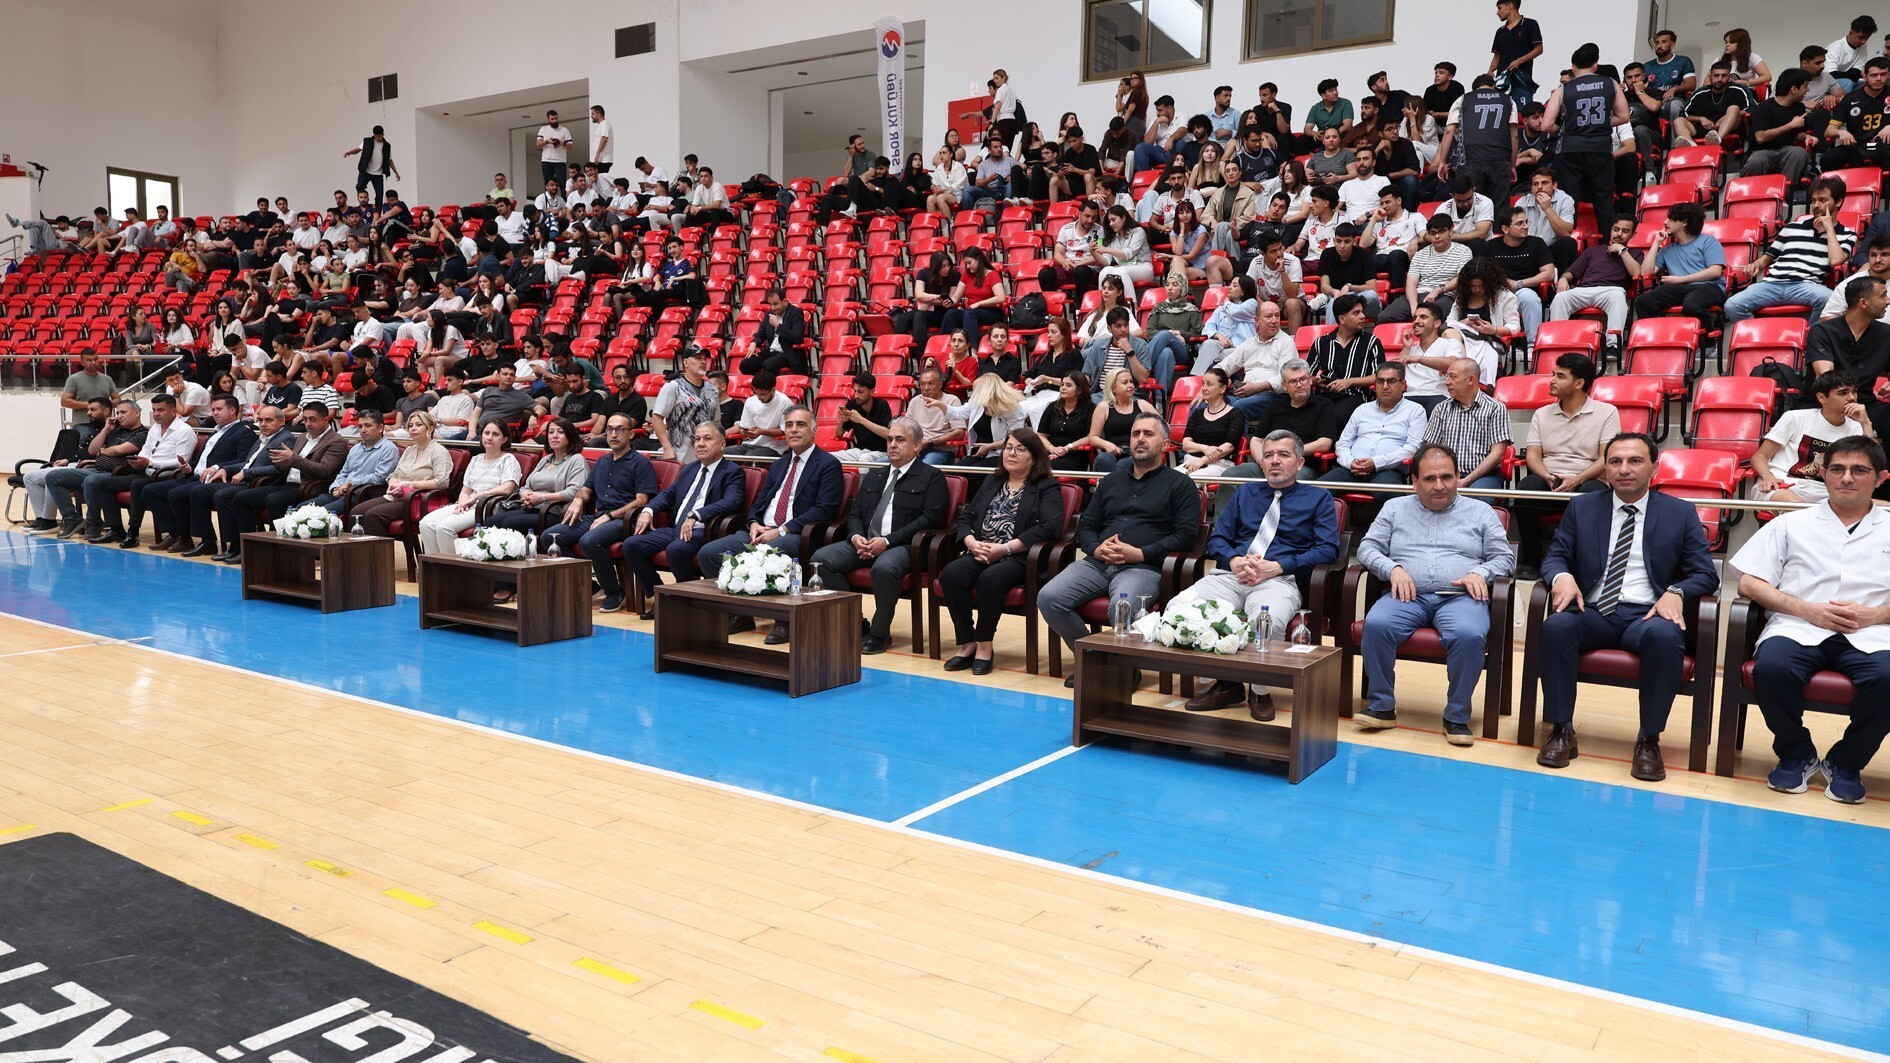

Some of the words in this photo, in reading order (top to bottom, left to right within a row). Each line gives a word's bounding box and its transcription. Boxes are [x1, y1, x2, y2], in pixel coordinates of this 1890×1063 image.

[1474, 103, 1504, 130] 77
[1576, 96, 1606, 127] 33
[1862, 113, 1882, 130] 33
